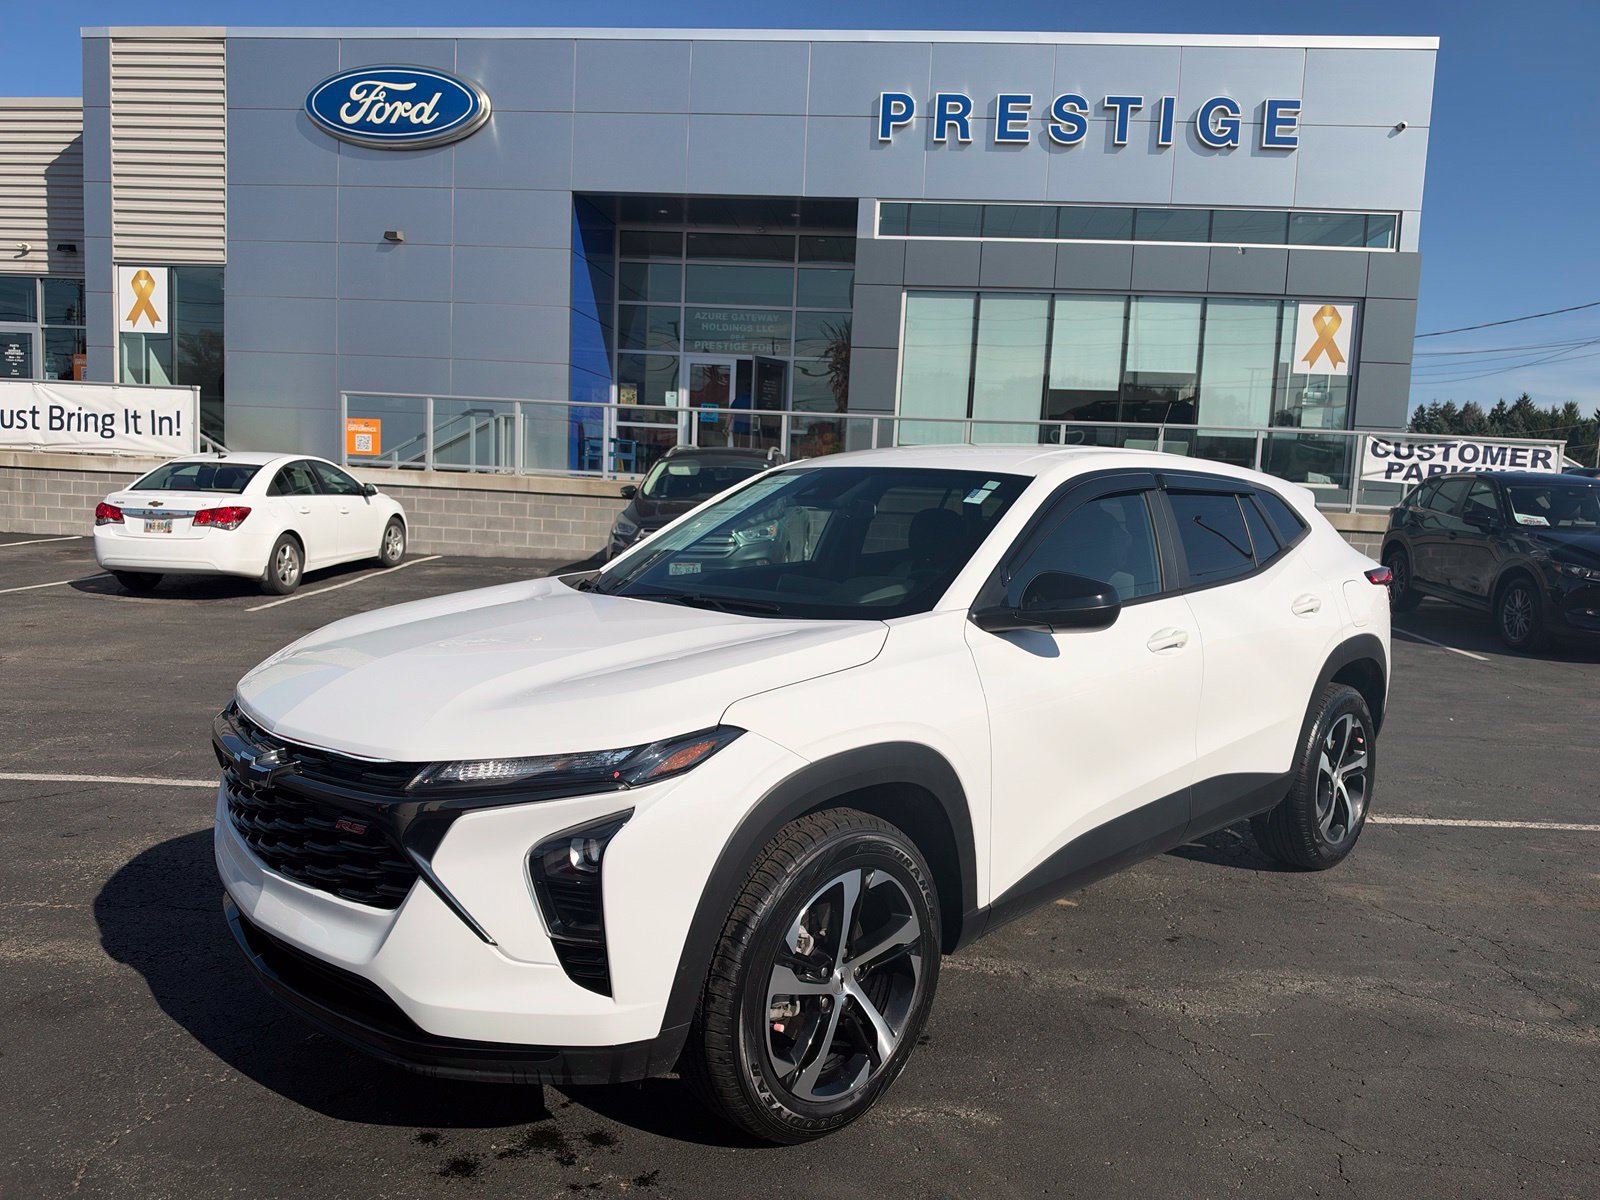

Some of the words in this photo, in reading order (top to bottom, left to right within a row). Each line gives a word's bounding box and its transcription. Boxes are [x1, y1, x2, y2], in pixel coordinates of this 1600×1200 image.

[340, 80, 442, 124] Ford
[878, 91, 1302, 149] PRESTIGE
[694, 311, 729, 321] AZURE
[731, 313, 780, 323] GATEWAY
[701, 322, 753, 332] HOLDINGS
[756, 325, 775, 333] LLC
[694, 341, 748, 351] PRESTIGE
[751, 343, 781, 353] FORD
[0, 405, 40, 430] ust
[49, 405, 115, 439] Bring
[124, 408, 142, 435] It
[151, 409, 181, 437] In!
[1370, 438, 1552, 470] CUSTOMER
[335, 819, 367, 834] RS
